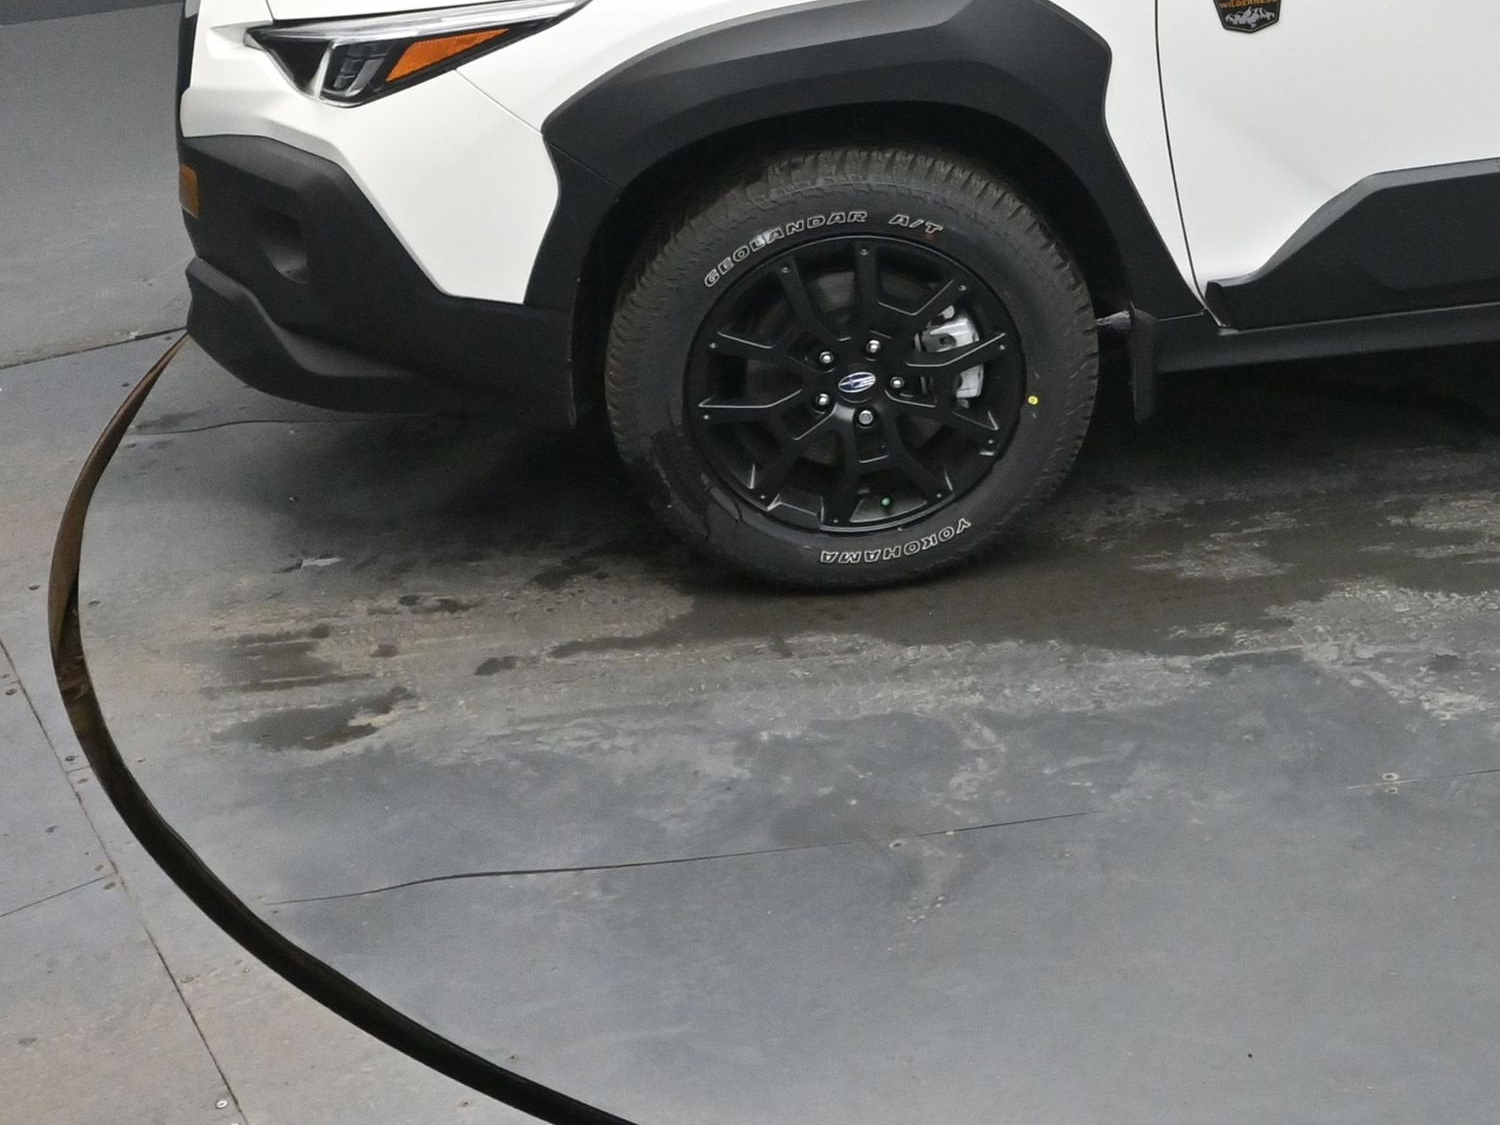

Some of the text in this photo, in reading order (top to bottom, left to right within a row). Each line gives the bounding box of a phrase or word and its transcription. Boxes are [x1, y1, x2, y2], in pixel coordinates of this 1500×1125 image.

[703, 211, 944, 288] GEOLANDAR A/T
[820, 516, 972, 564] YOKOHAMA
